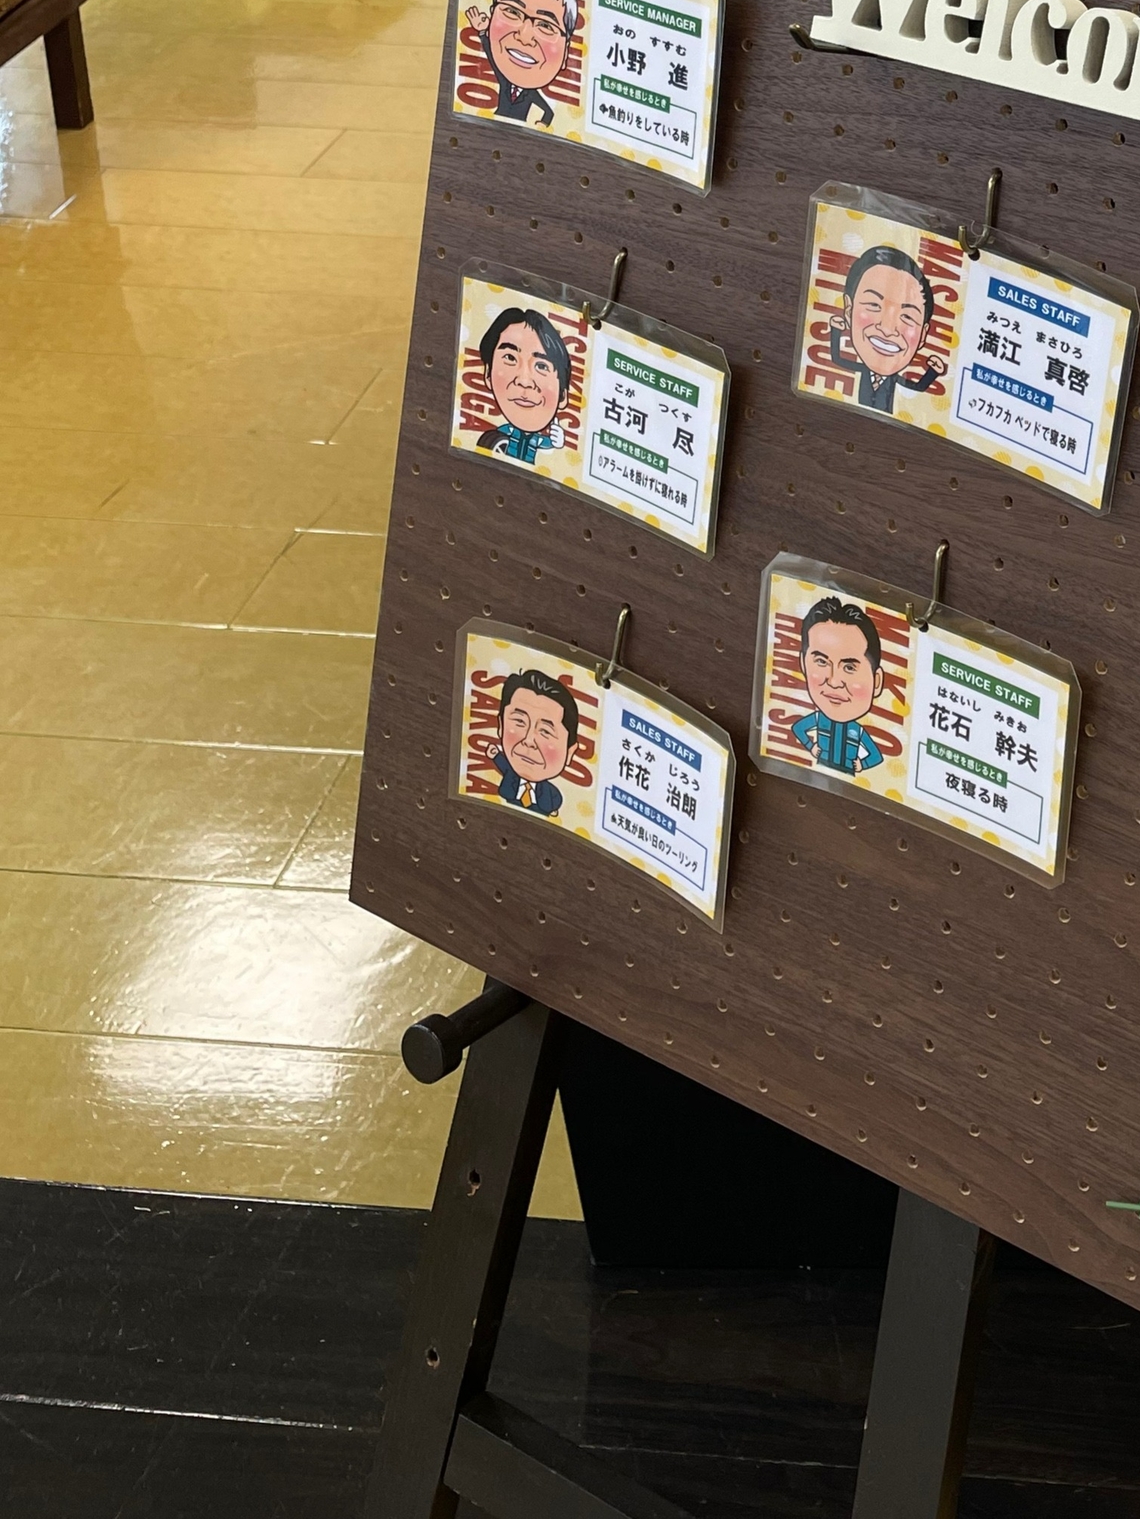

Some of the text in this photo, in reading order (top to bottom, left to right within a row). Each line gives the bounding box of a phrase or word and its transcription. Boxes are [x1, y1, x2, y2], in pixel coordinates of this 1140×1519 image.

[613, 24, 687, 56] おの すすむ
[647, 8, 696, 32] MANAGER
[457, 27, 500, 109] ONO
[606, 42, 688, 90] 小野 進
[608, 105, 689, 146] 魚釣りをしている時
[997, 285, 1081, 327] SALES STAFF
[986, 310, 1084, 359] みつえ まさひろ
[614, 357, 693, 399] SERVICE STAFF
[977, 328, 1091, 397] 満江 真啓
[603, 397, 695, 456] 古河 尽
[615, 382, 692, 423] こが つくす
[937, 685, 1027, 733] はないし みきお
[941, 662, 1032, 709] SERVICE STAFF
[629, 717, 695, 762] SALES STAFF
[928, 703, 1038, 773] 花石 幹夫
[618, 756, 697, 821] 作花 治朗
[621, 738, 701, 792] さくか じろう
[945, 771, 1008, 813] 夜寝る時
[618, 814, 698, 872] 天気が良い日のツーリング
